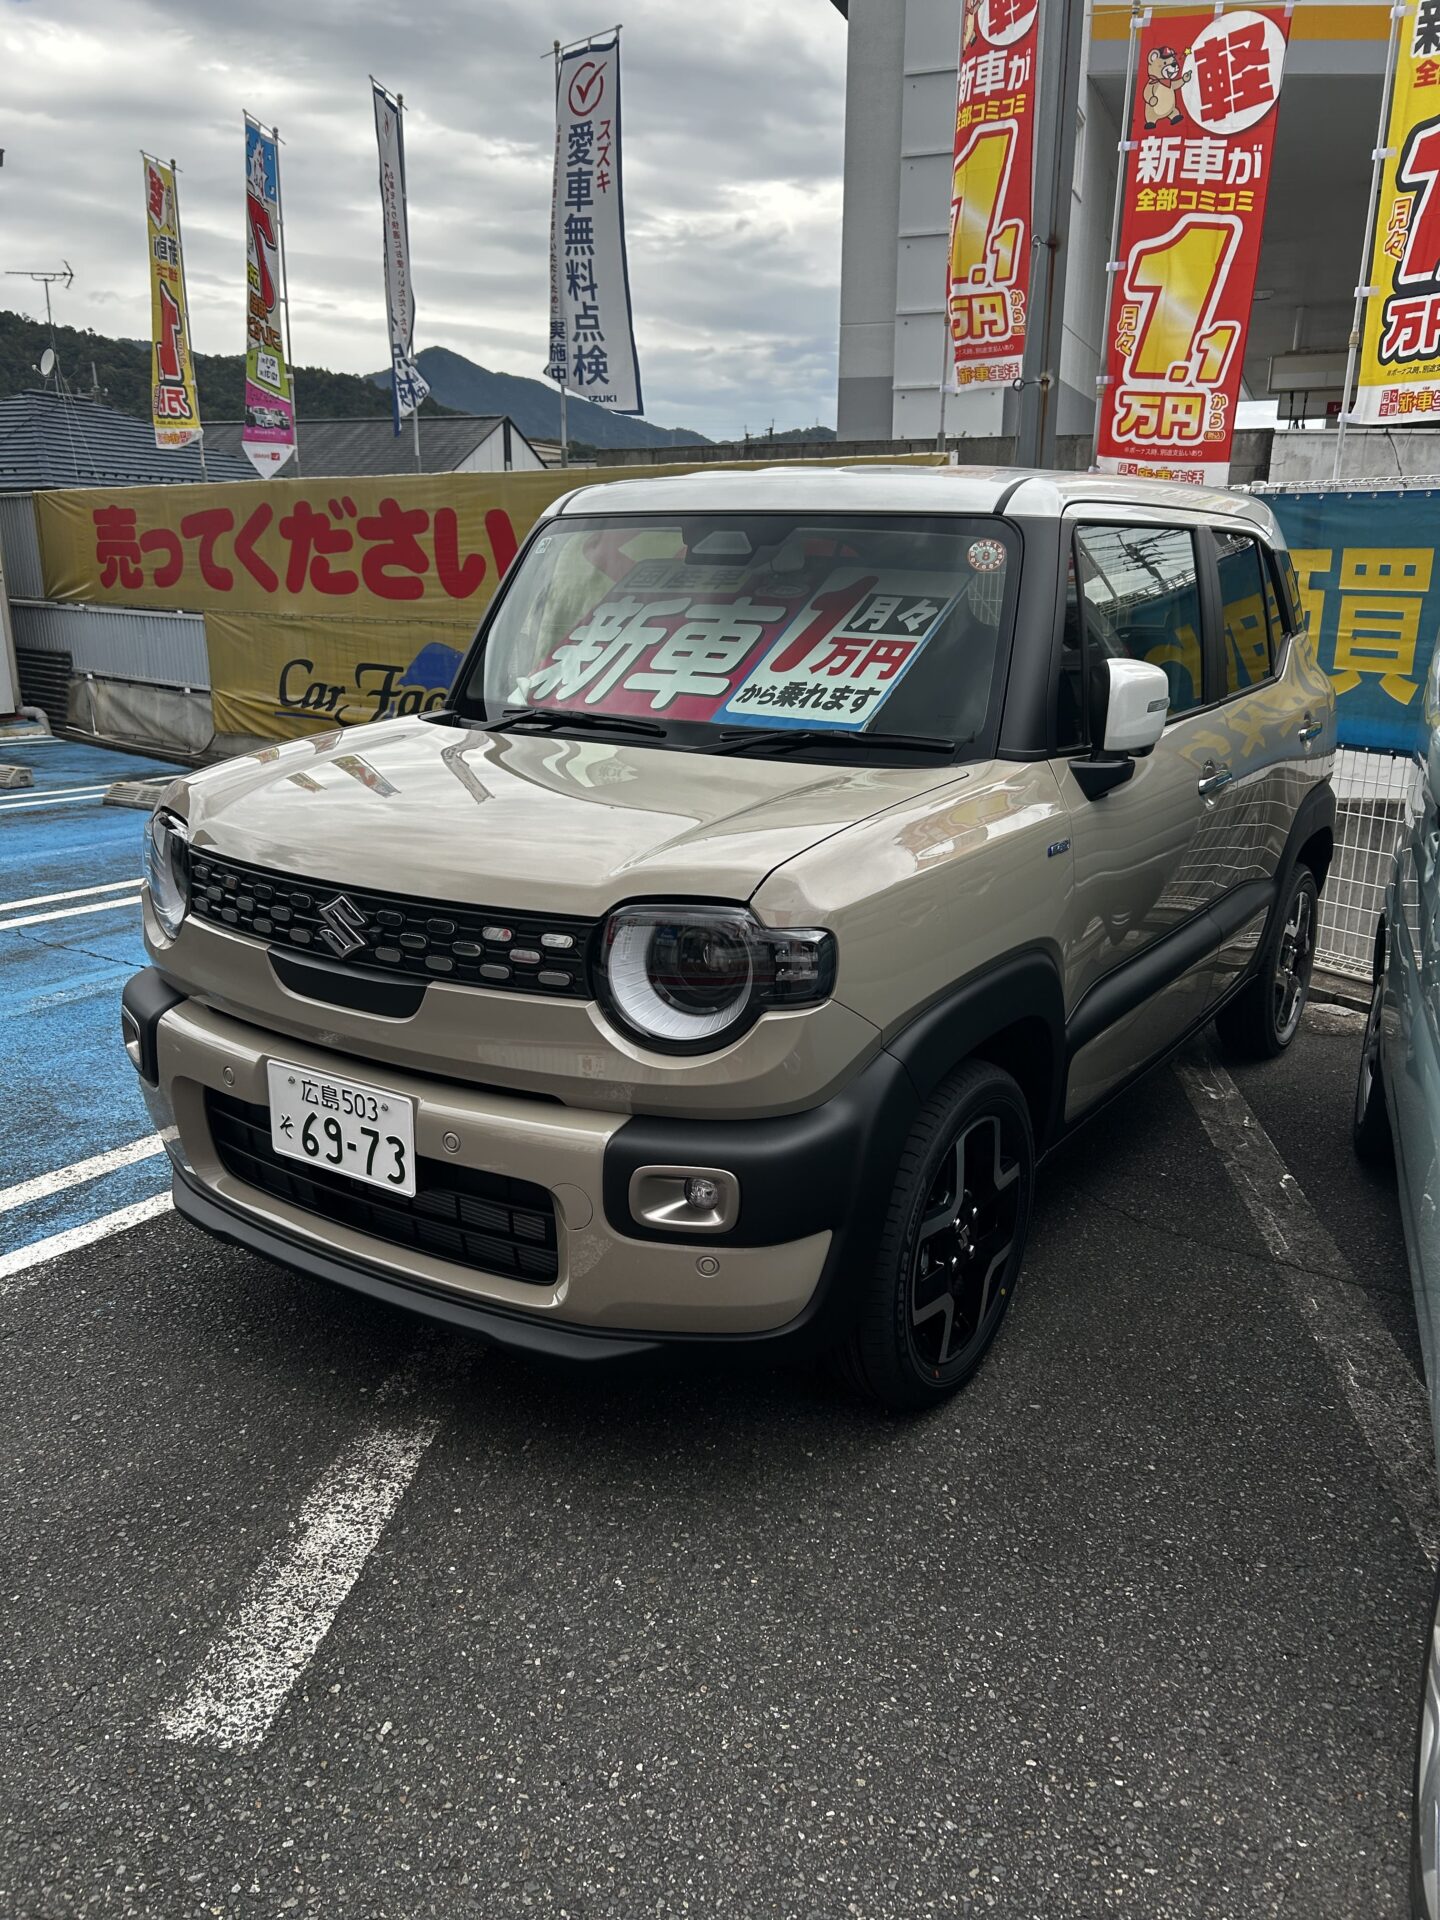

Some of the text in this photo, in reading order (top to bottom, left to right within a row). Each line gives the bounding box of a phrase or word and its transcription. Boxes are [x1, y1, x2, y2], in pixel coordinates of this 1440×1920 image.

[957, 48, 1031, 107] 新車が
[1193, 21, 1274, 122] 軽
[597, 120, 611, 194] スズキ
[1136, 136, 1263, 185] 新車が
[1135, 188, 1255, 212] 全部コミコミ
[1387, 199, 1412, 259] 月々
[564, 120, 609, 385] 愛車無料点検
[1011, 291, 1025, 323] から
[1116, 305, 1139, 357] 月々
[1127, 222, 1237, 384] 1.1
[550, 321, 568, 384] 実施中
[1117, 391, 1206, 440] 万円
[1209, 395, 1226, 429] から
[93, 496, 518, 600] 売ってください
[770, 576, 880, 673] 1
[850, 596, 939, 632] 月々
[529, 596, 787, 708] 新車
[808, 637, 917, 679] 万円
[278, 659, 346, 711] Car
[735, 682, 882, 713] から乗れます
[279, 1112, 406, 1184] そ 69-73
